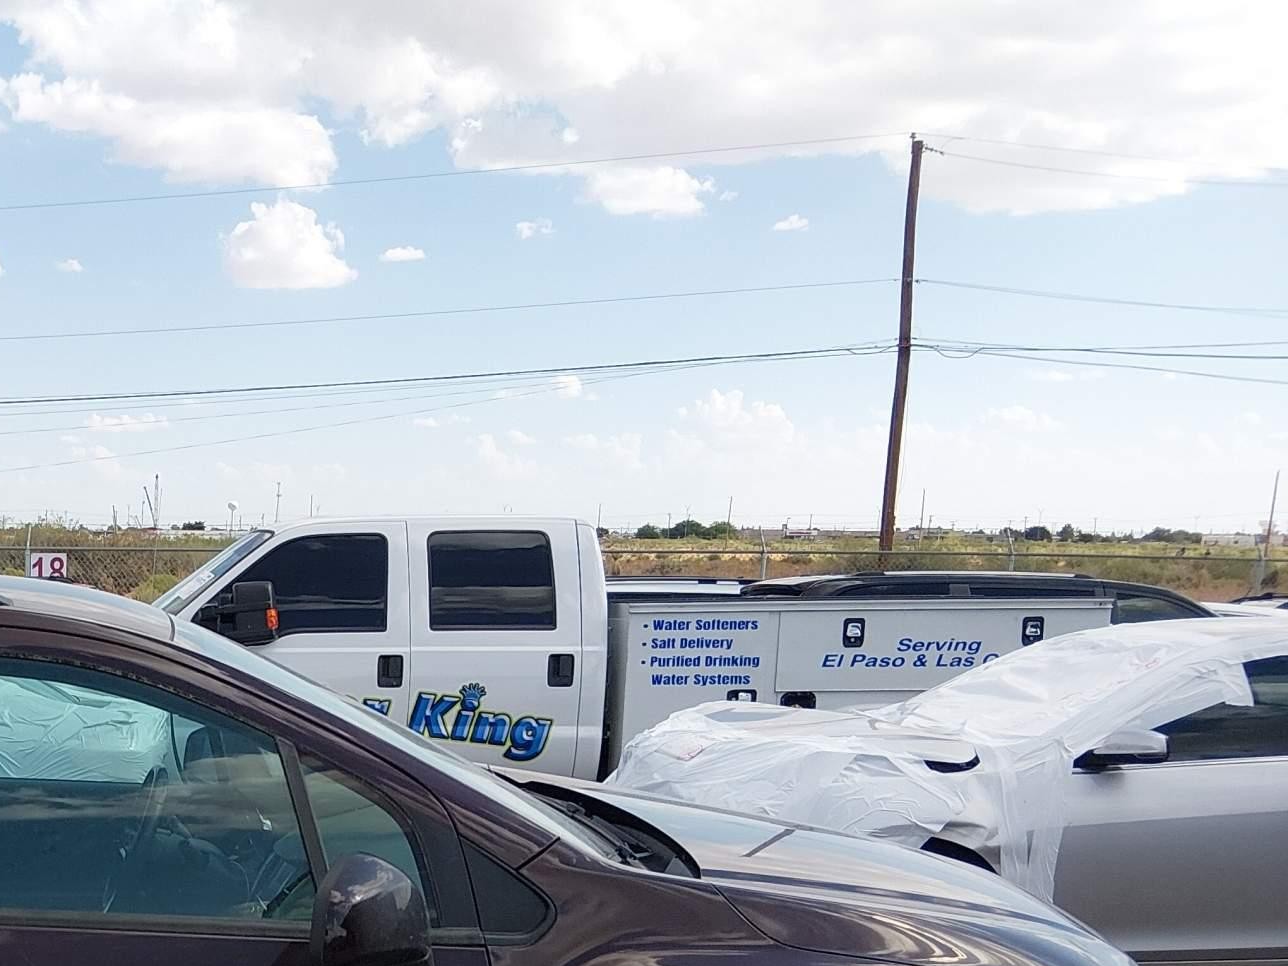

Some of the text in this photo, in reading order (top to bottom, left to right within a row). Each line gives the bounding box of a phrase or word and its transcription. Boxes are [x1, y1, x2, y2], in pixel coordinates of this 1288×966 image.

[32, 557, 64, 577] 18
[653, 619, 758, 631] Water Softeners
[651, 637, 733, 650] Salt Delivery
[897, 638, 982, 654] Serving
[650, 655, 760, 668] Purified Drinking
[822, 654, 844, 668] El
[850, 654, 905, 668] Paso
[913, 654, 927, 668] &
[936, 654, 975, 668] Las
[651, 674, 751, 686] Water Systems
[408, 683, 553, 761] King
